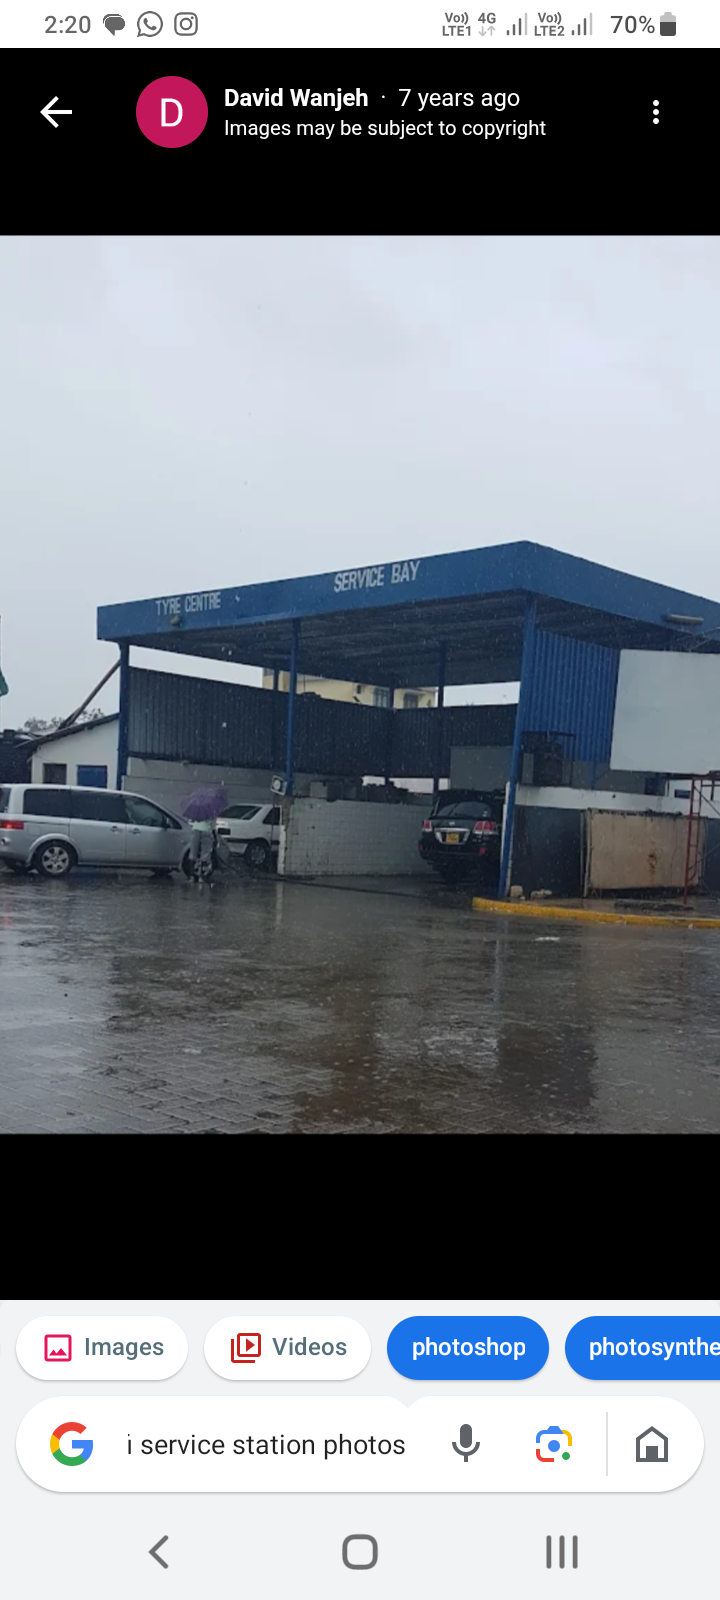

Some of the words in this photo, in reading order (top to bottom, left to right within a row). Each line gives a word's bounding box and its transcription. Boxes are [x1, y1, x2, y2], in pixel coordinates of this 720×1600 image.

[333, 566, 385, 593] SERVICE
[390, 560, 420, 584] BAY
[155, 597, 181, 616] TYRE
[184, 591, 221, 613] CENTRE
